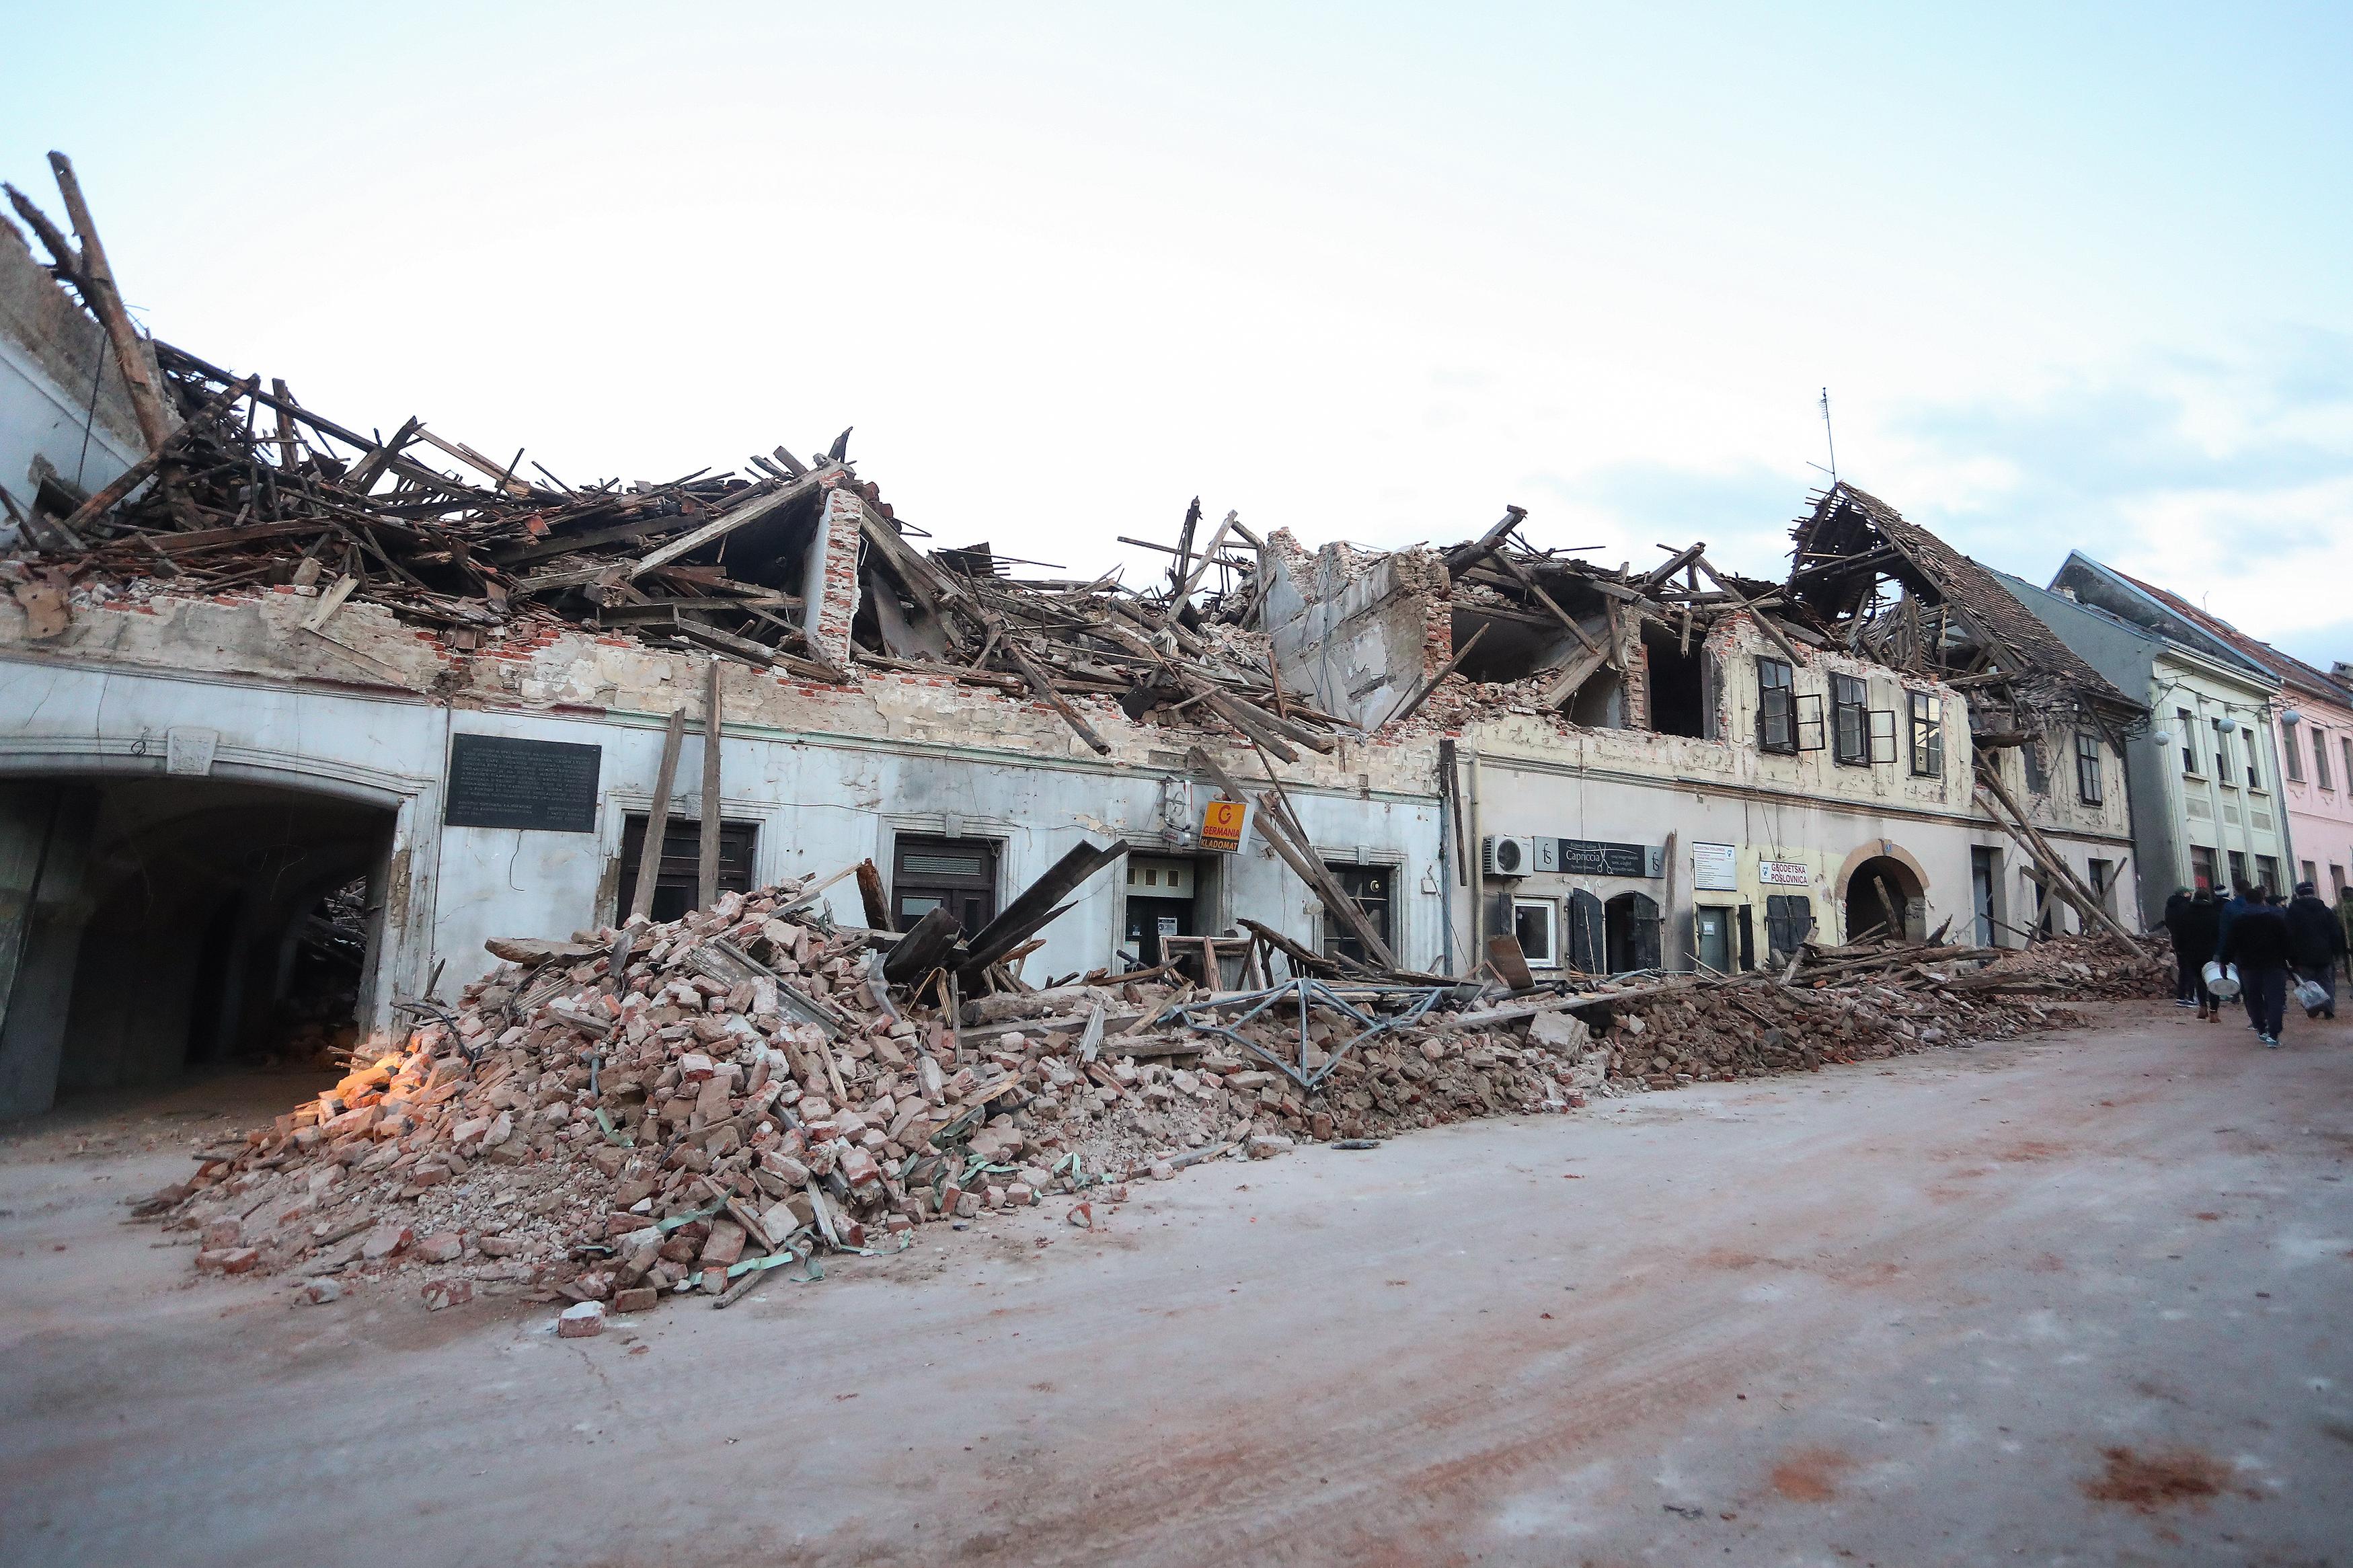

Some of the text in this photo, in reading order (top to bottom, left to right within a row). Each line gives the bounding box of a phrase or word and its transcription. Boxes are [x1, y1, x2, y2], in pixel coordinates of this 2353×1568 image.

[1203, 826, 1239, 838] GERMANIA
[1200, 838, 1238, 851] KLADOMAT
[1566, 850, 1600, 863] Capriccia
[1771, 863, 1806, 874] GEODETSKA
[1771, 874, 1808, 884] POSLOVNICA
